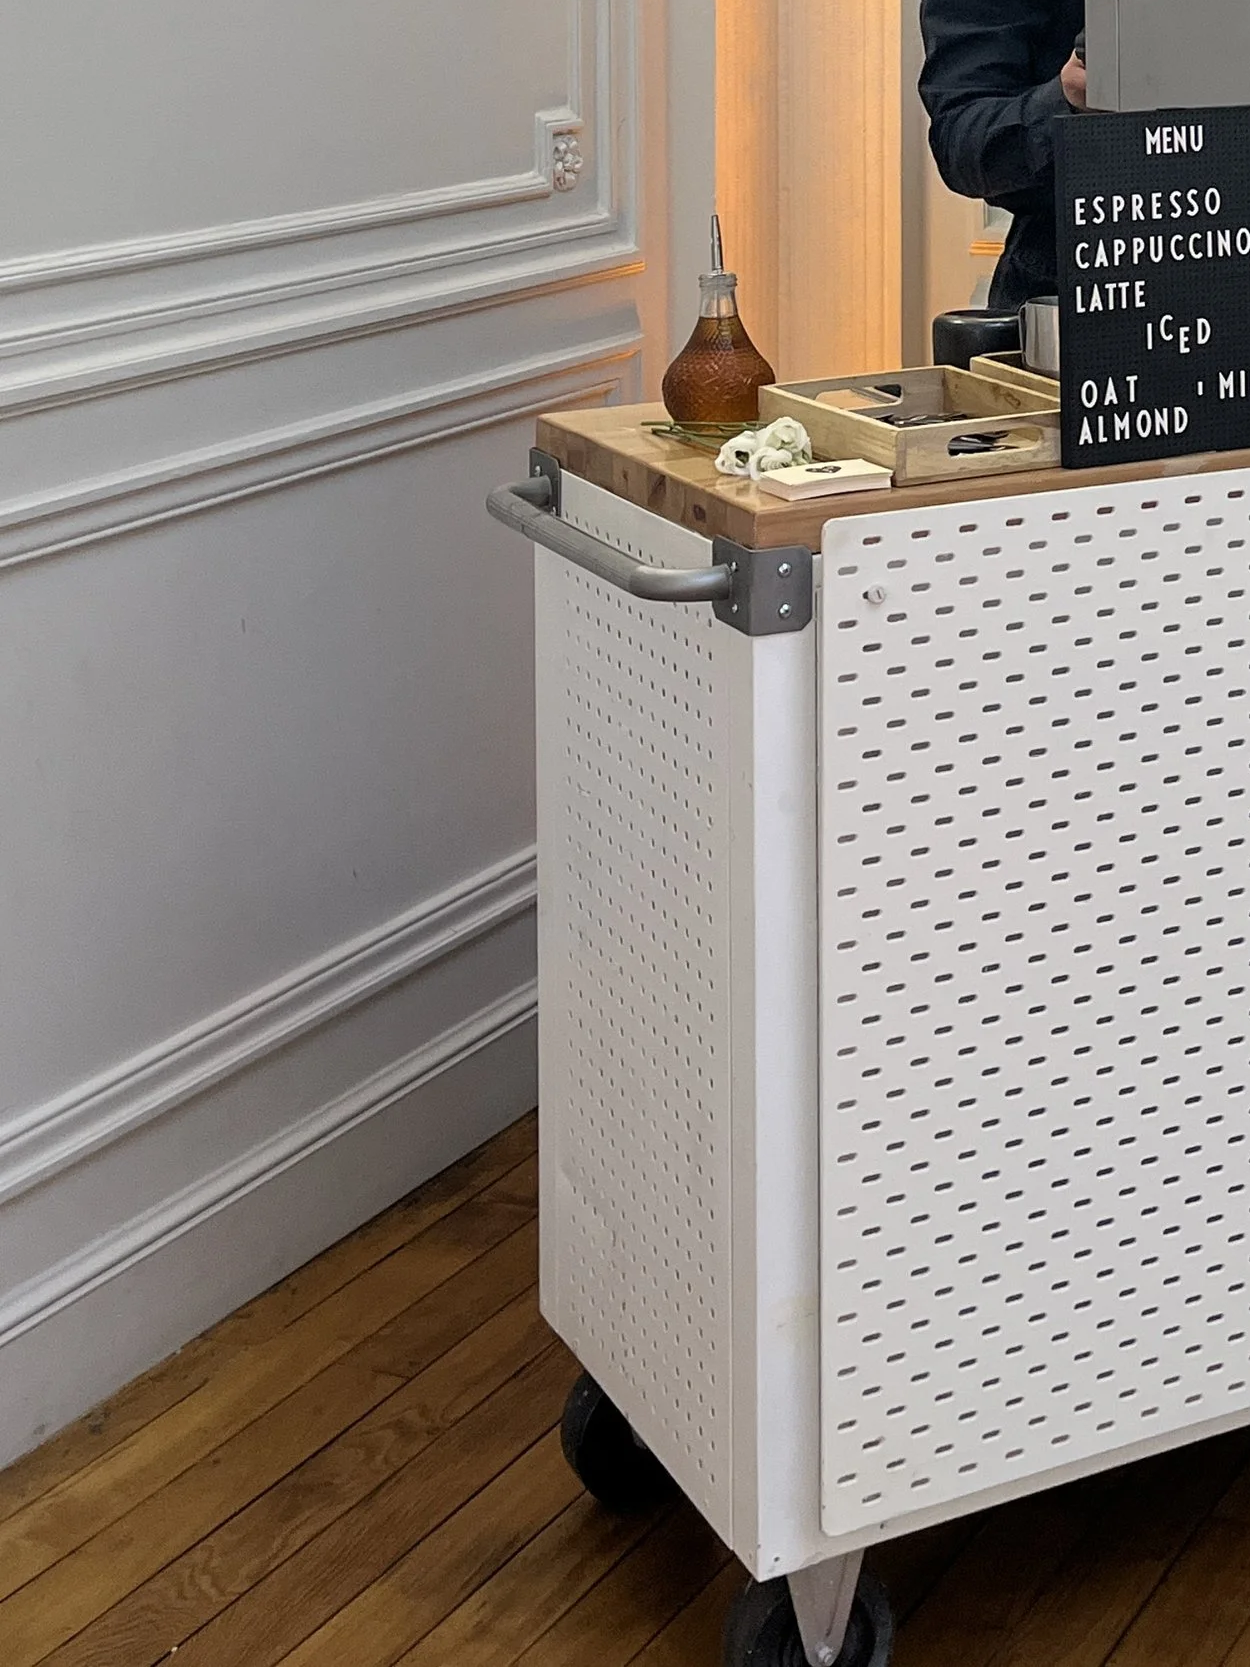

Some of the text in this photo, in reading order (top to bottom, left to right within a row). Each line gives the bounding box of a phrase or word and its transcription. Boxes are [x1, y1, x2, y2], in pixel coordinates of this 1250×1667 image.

[1145, 124, 1203, 155] MENU
[1074, 187, 1221, 226] ESPRESSO
[1075, 280, 1146, 314] LATTE
[1146, 314, 1211, 354] ICED
[1080, 375, 1139, 409] OAT
[1078, 406, 1189, 446] ALMOND
